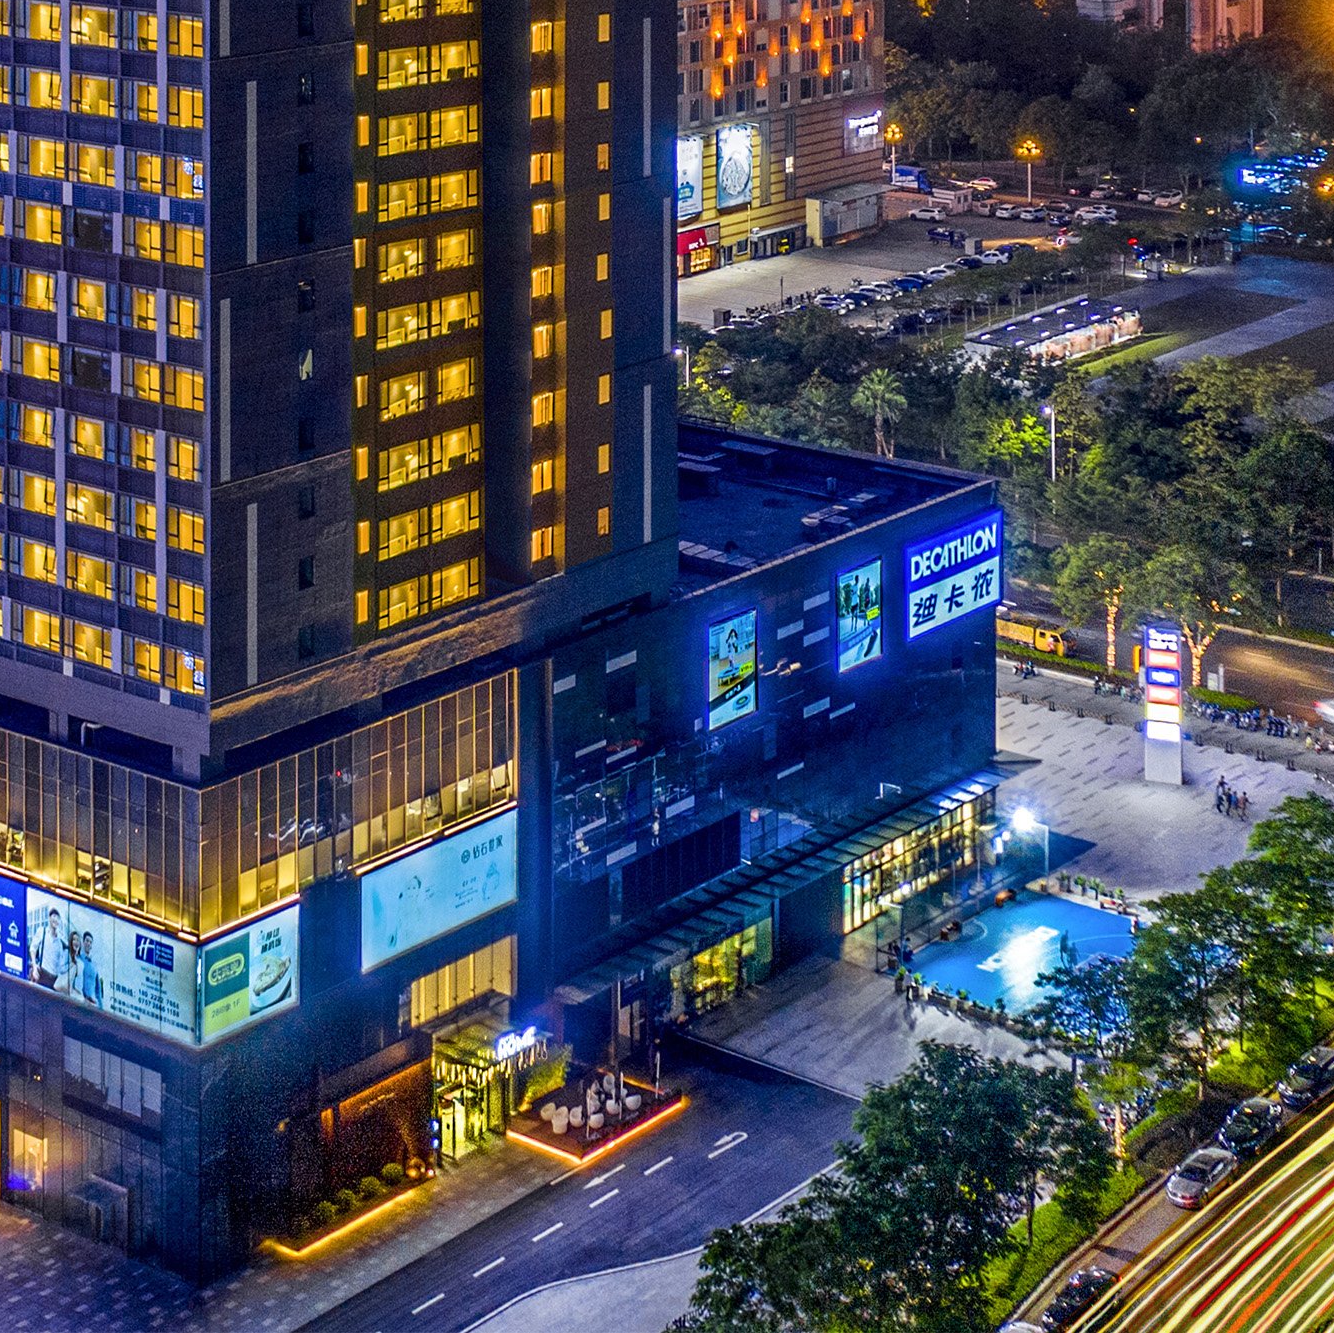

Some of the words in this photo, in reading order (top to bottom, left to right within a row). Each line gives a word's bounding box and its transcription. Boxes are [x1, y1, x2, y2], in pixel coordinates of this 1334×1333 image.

[911, 524, 998, 579] DECATHLON
[912, 569, 995, 626] 迪卡侬
